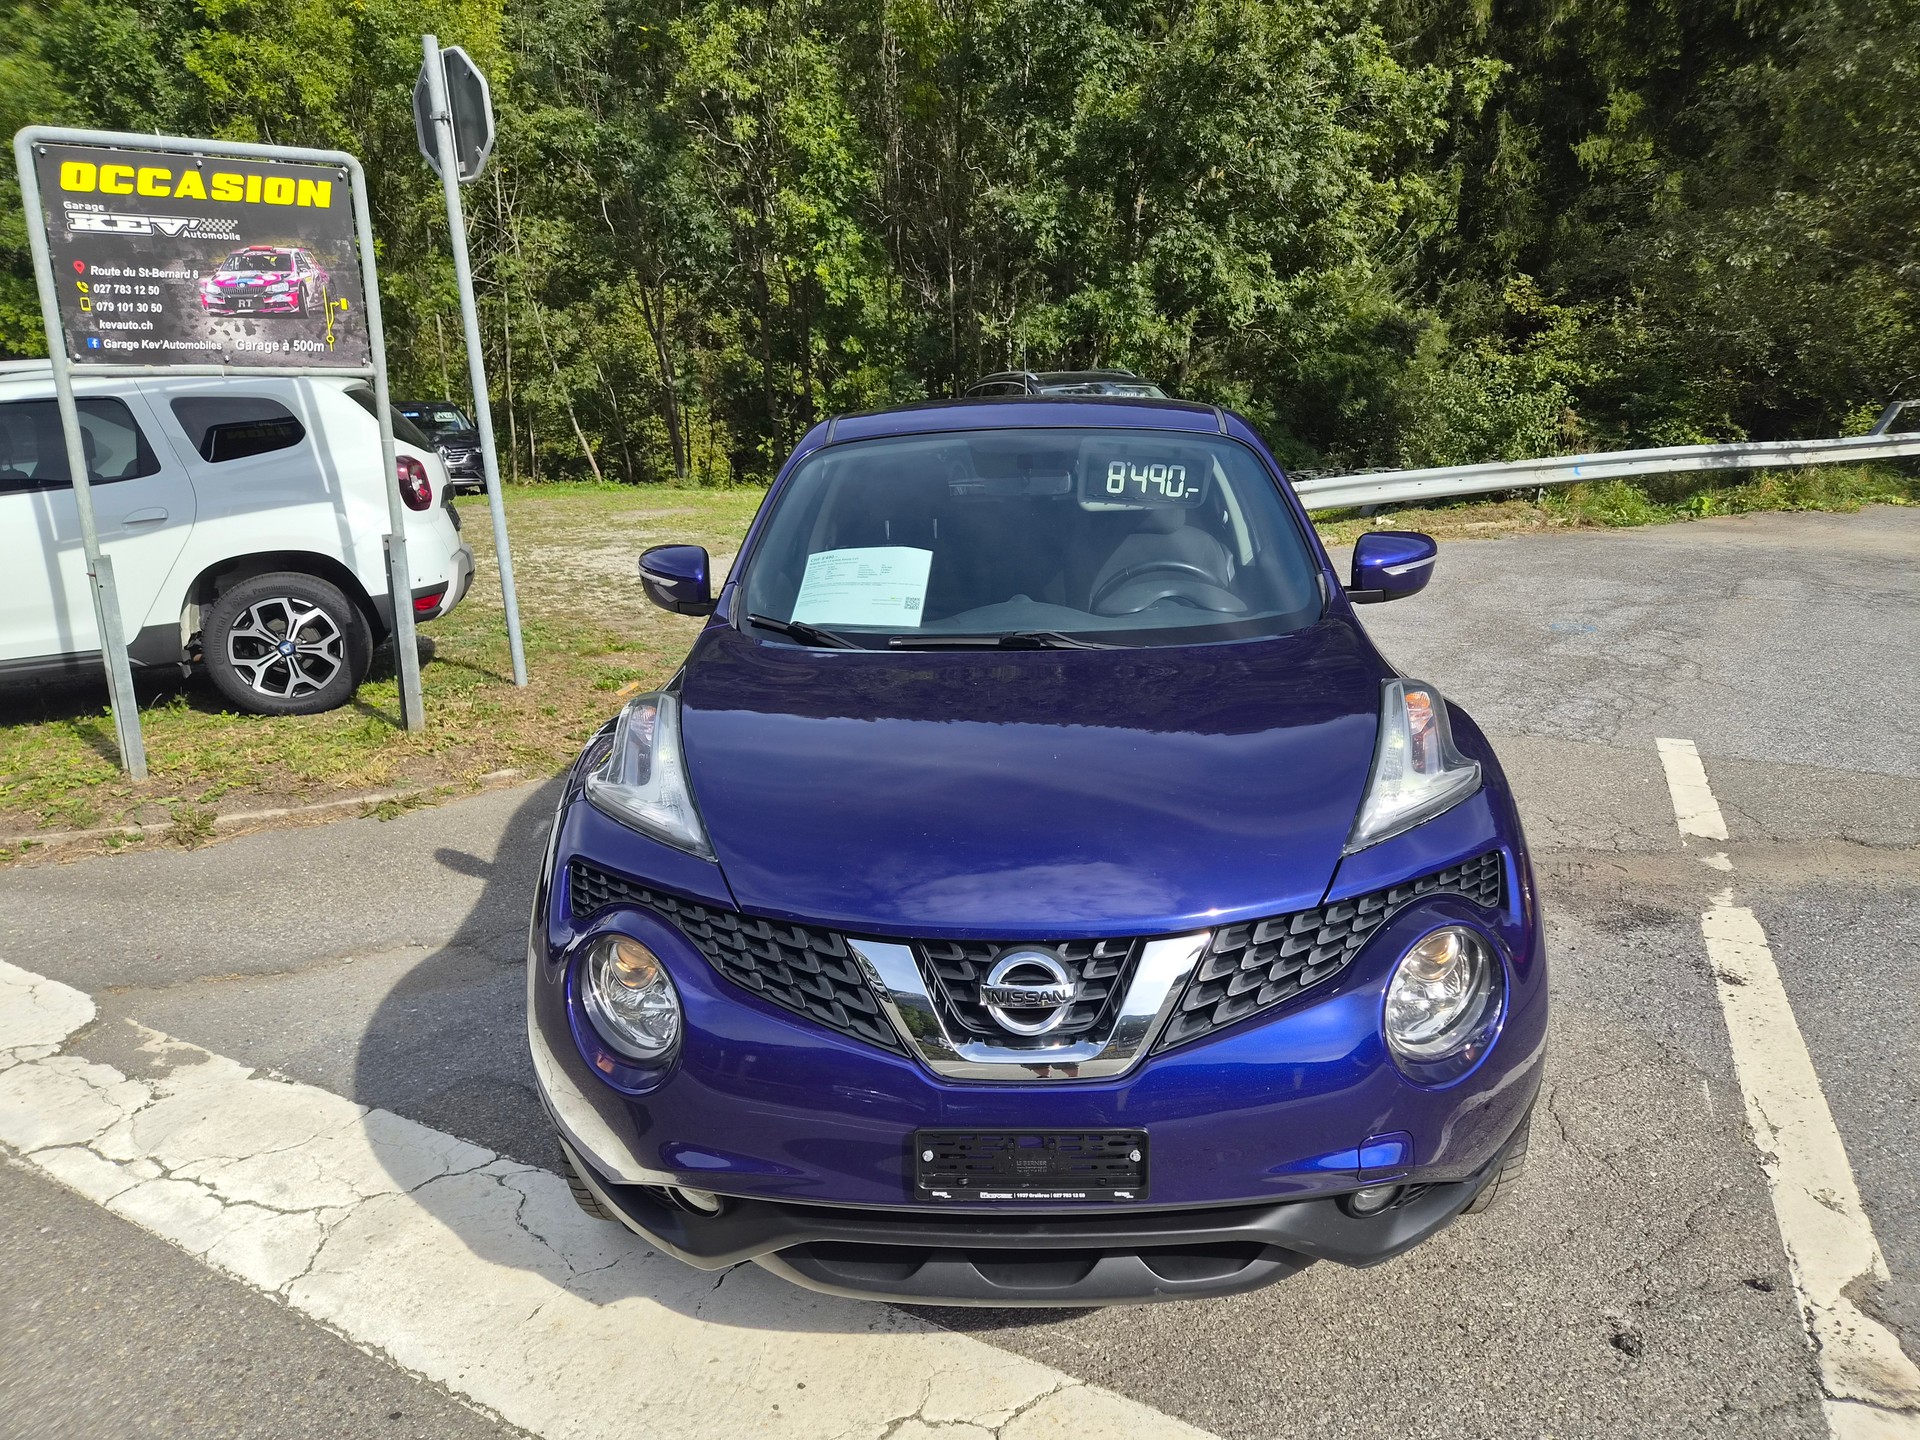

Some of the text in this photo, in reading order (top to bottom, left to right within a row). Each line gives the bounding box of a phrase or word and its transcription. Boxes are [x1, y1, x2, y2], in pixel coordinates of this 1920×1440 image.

[60, 161, 332, 208] OCCASION
[63, 201, 105, 212] Garage
[182, 231, 241, 240] Automobile
[90, 266, 199, 279] Route du St-Bernard 8
[93, 284, 160, 295] 027 783 12 50
[96, 302, 162, 313] 079 101 30 50
[238, 300, 252, 308] RT
[99, 320, 153, 330] kevauto.ch
[103, 339, 222, 351] Garage Kev'Automobiles
[235, 339, 325, 353] Garage à 500m
[991, 989, 1066, 1004] NISSAN
